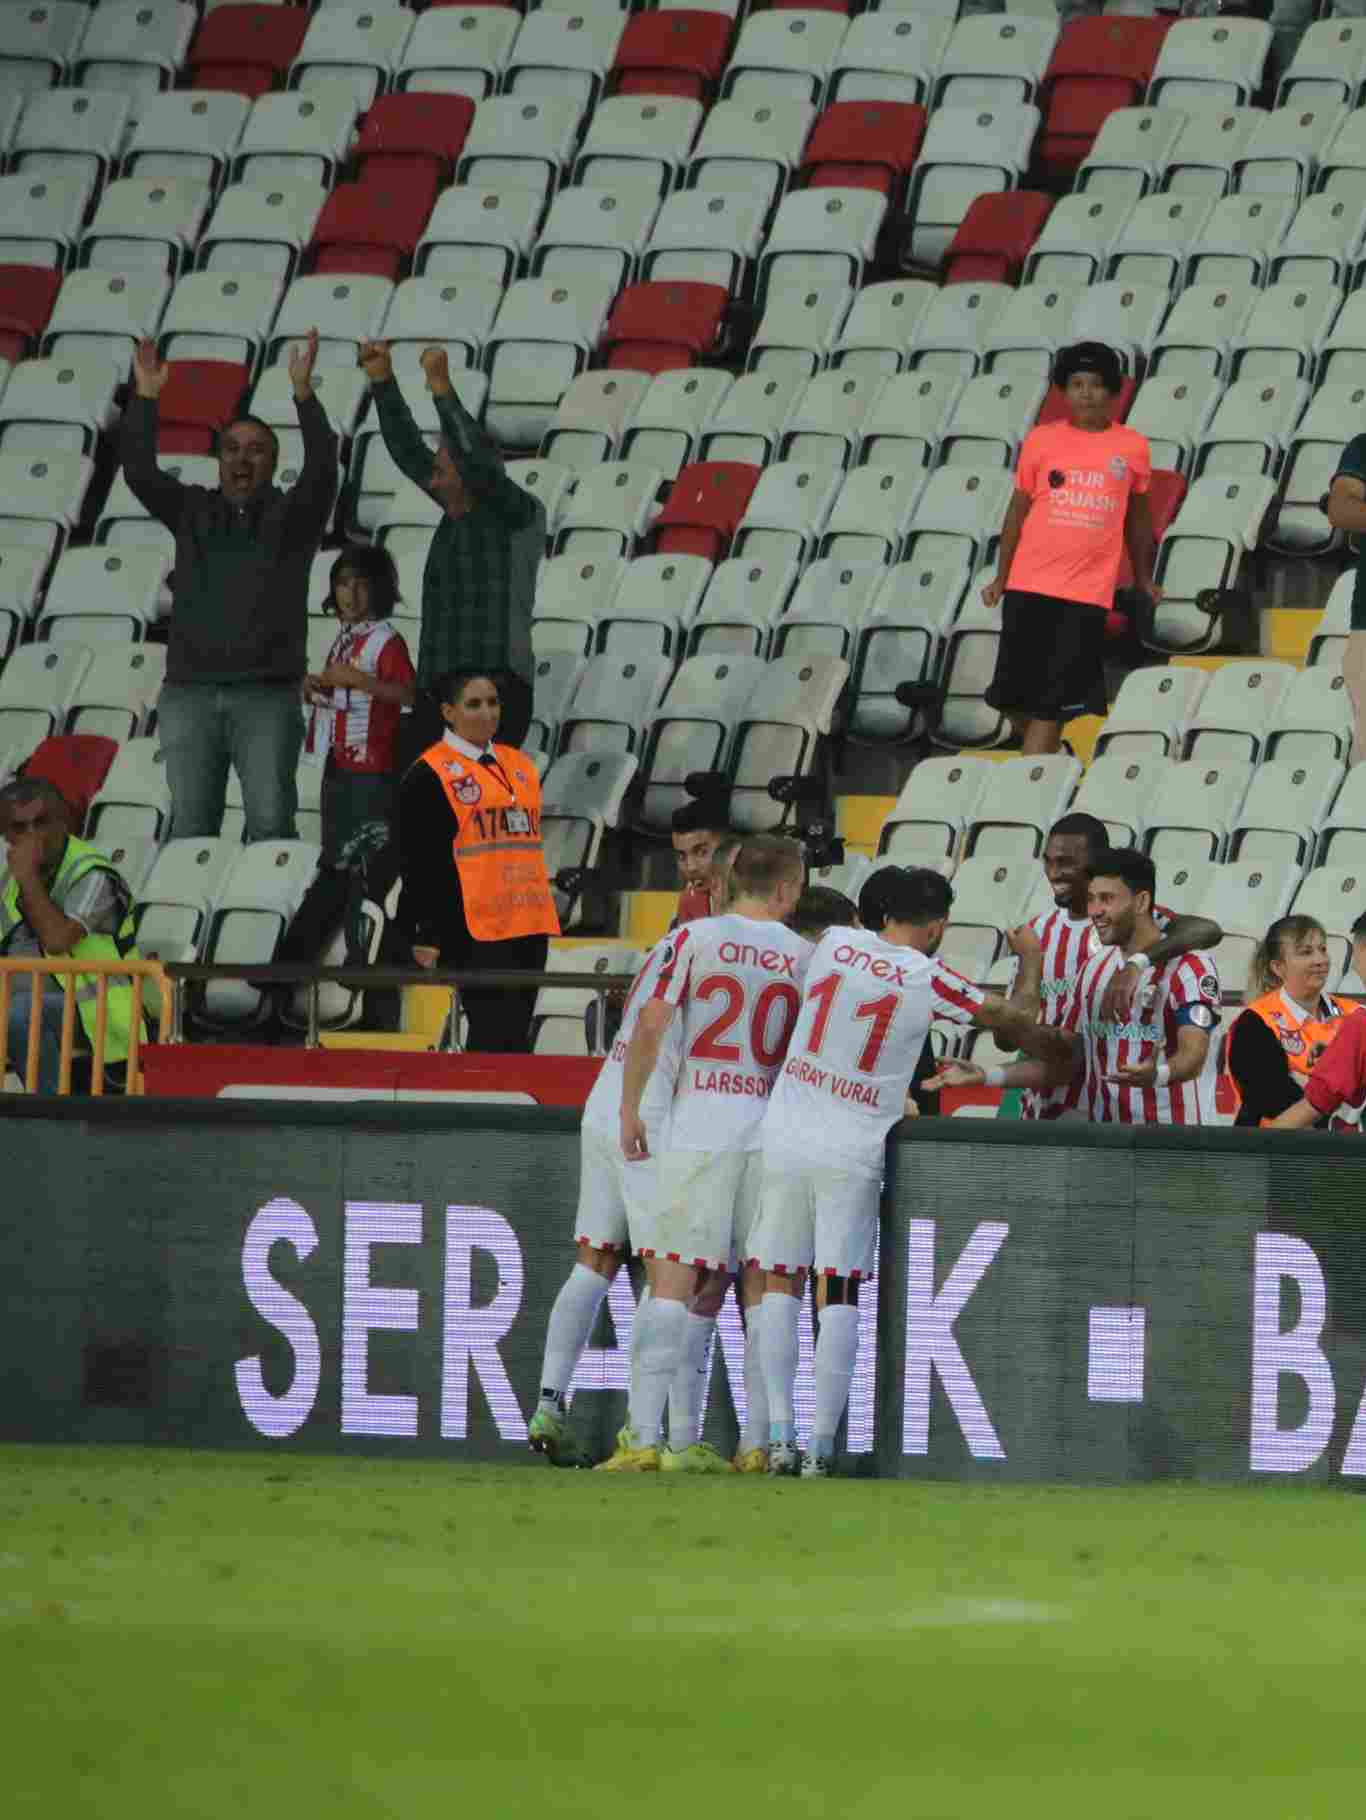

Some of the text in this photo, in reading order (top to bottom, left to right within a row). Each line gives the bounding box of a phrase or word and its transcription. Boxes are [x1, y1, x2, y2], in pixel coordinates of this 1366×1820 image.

[719, 941, 796, 978] anex
[833, 944, 908, 987] anex
[688, 973, 802, 1070] 20
[805, 970, 904, 1074] 11
[784, 1056, 880, 1108] GRAY VURAL
